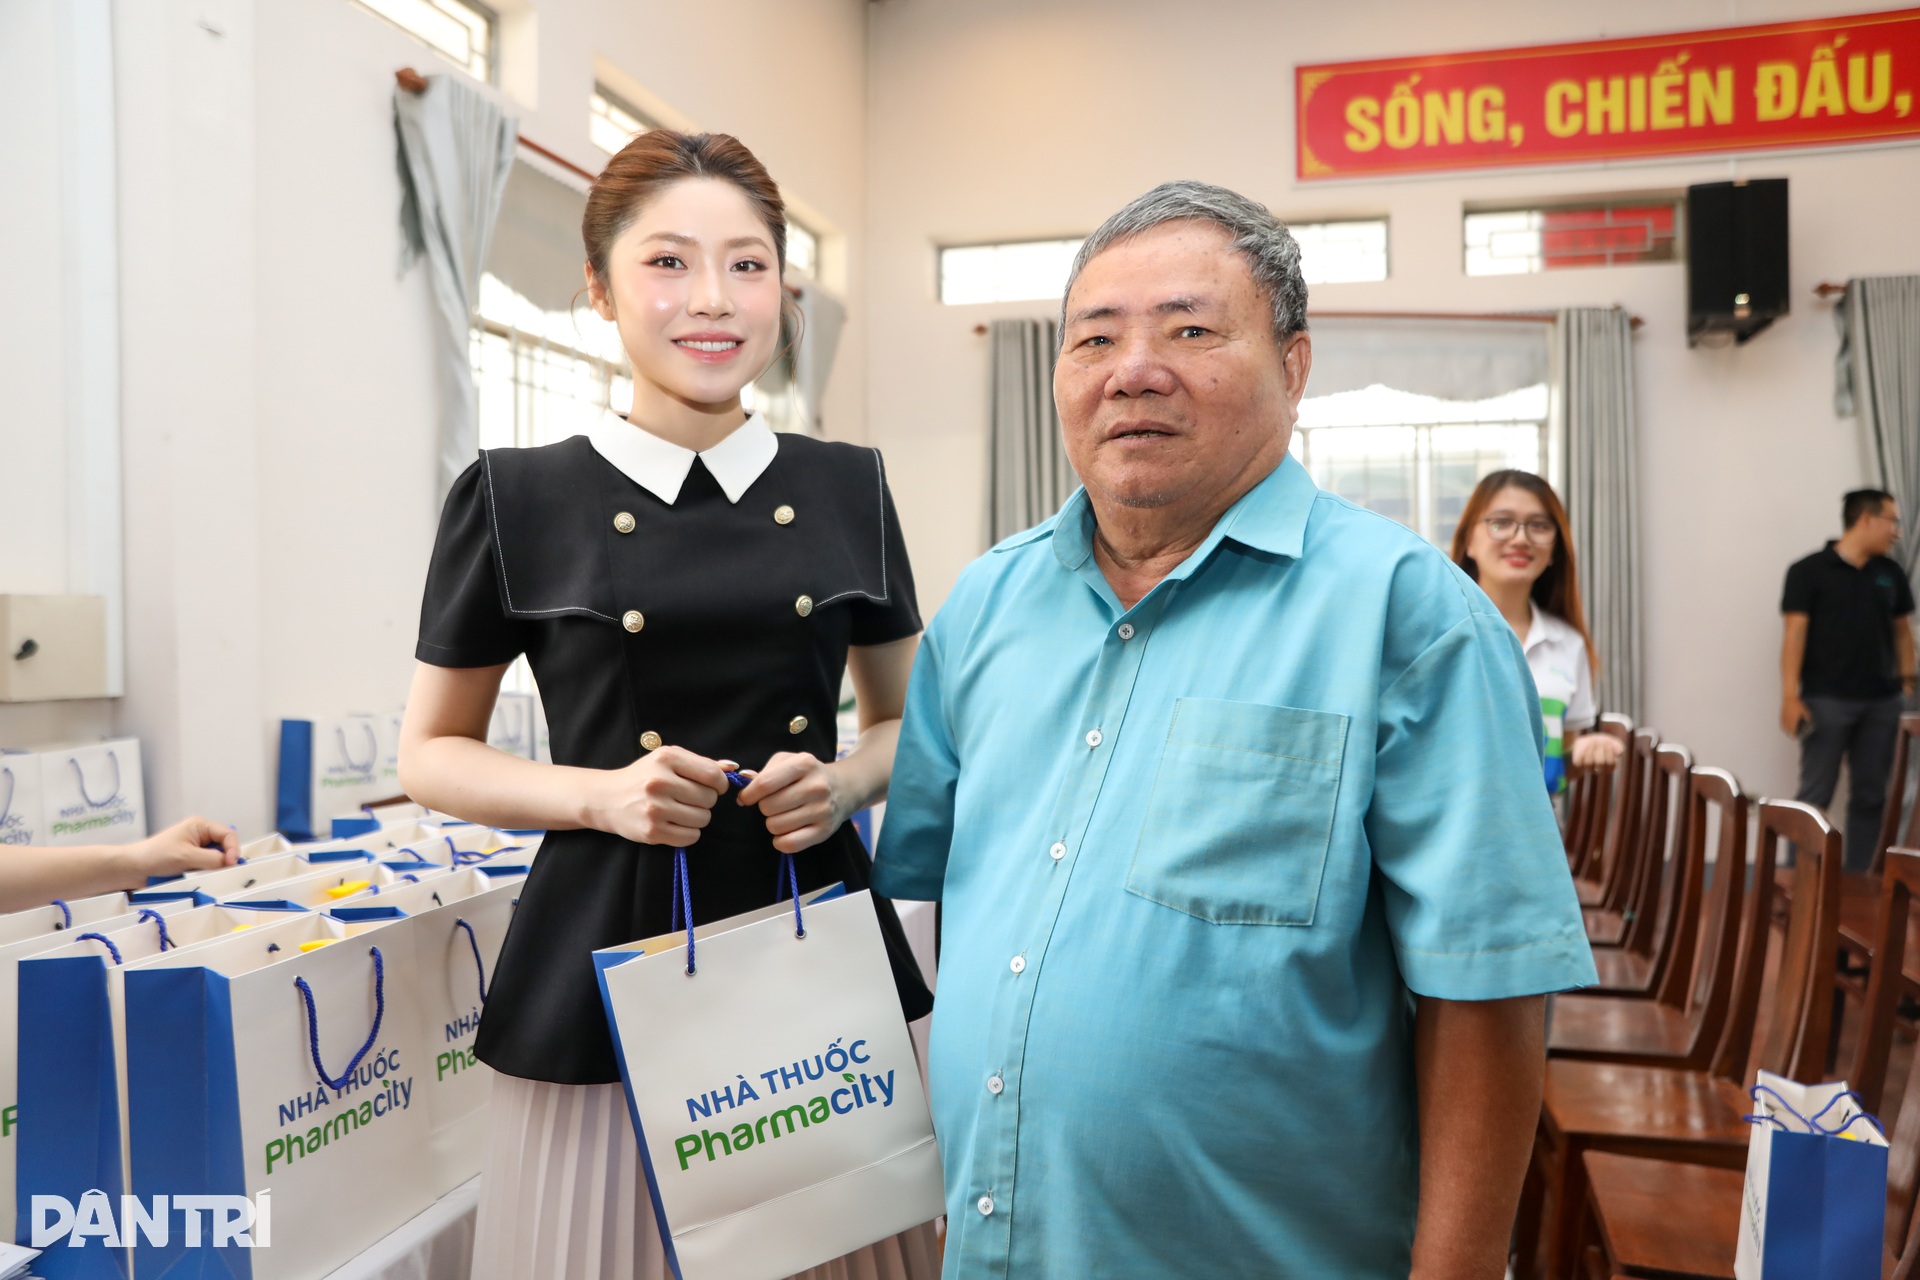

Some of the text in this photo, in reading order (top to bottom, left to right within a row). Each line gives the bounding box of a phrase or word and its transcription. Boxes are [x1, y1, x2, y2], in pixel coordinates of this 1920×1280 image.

[1345, 33, 1913, 153] SỐNG, CHIẾN ĐẤU,
[265, 1077, 413, 1175] Pharmacity
[279, 1080, 330, 1127] NHÀ
[674, 1069, 895, 1171] Pharmacity
[686, 1037, 871, 1123] NHÀ THUỐC
